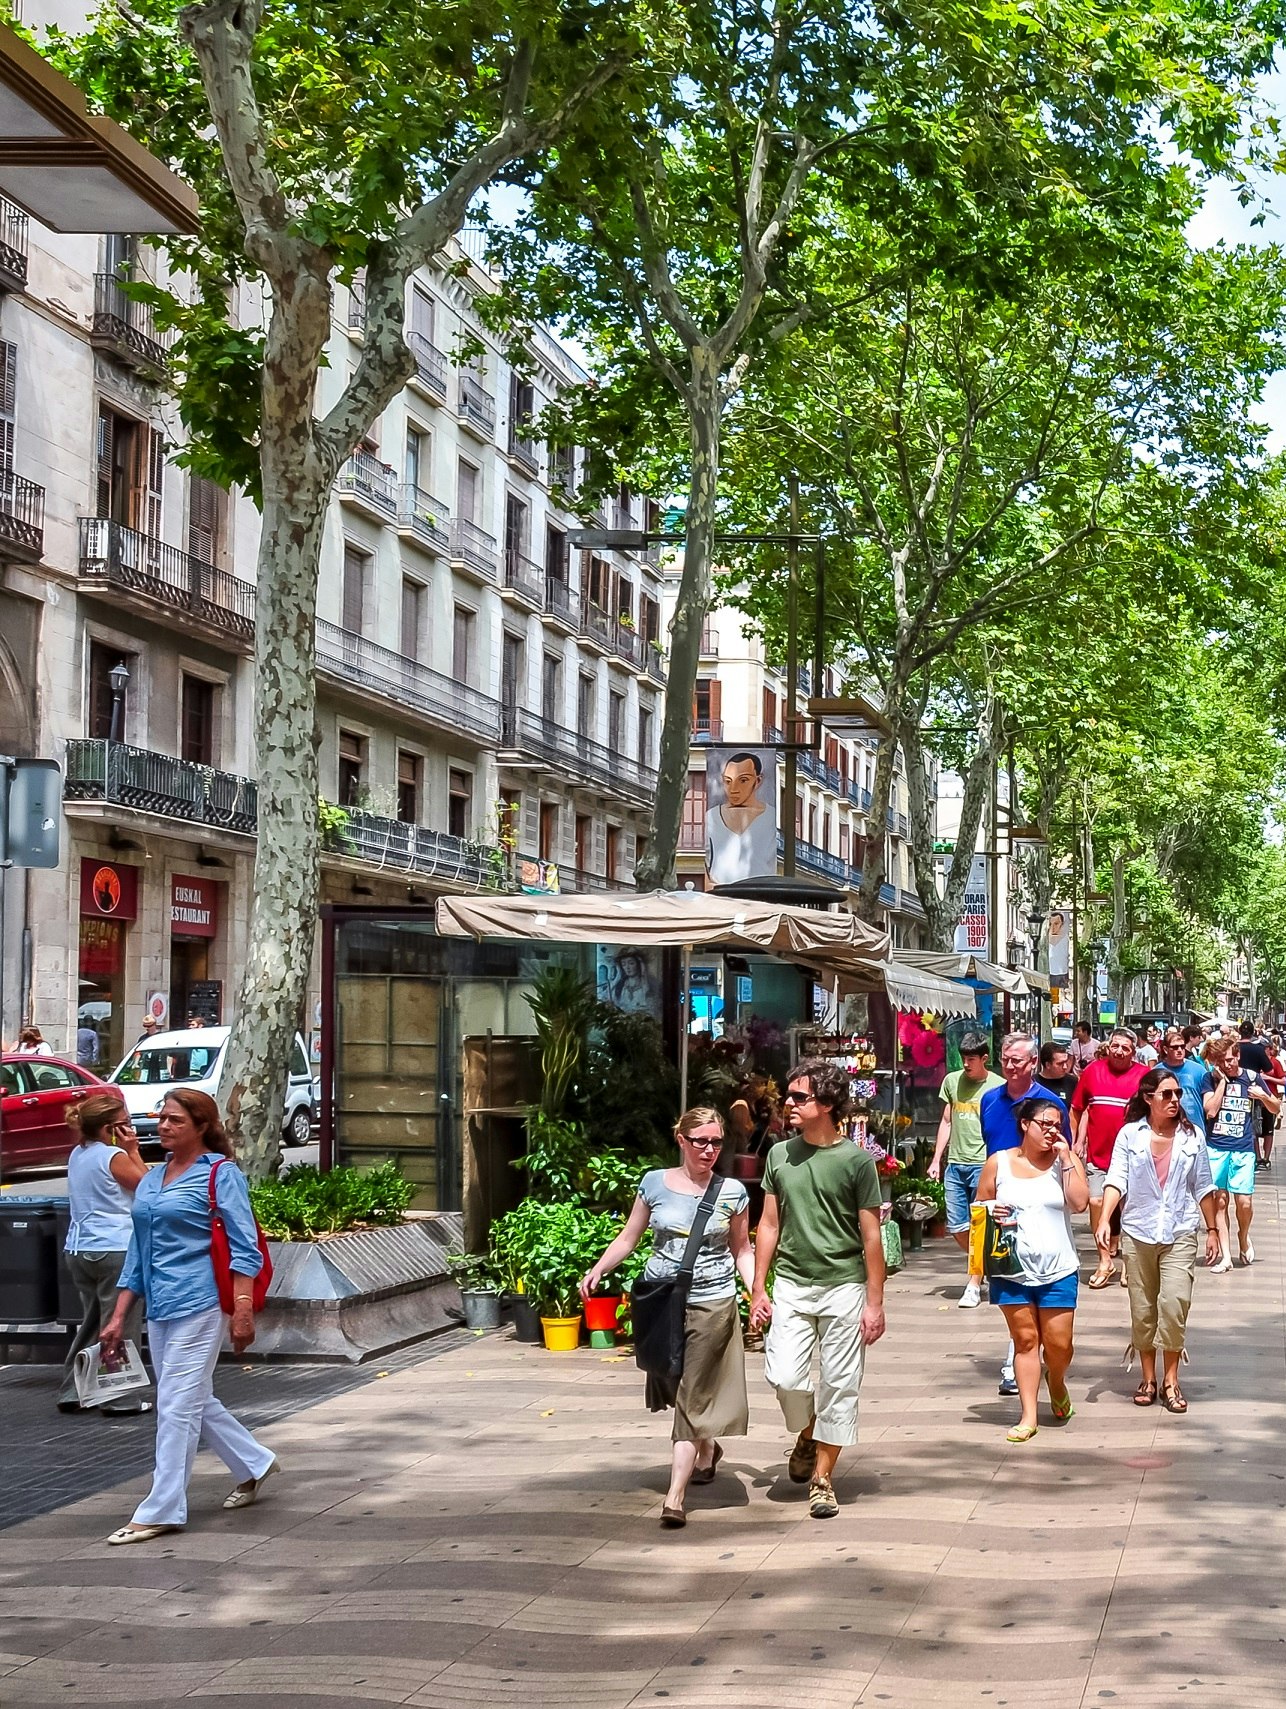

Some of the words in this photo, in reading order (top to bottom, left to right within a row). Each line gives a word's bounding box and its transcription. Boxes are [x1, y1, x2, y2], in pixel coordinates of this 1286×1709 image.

[175, 886, 202, 904] EUSKAL
[964, 893, 985, 904] ORAR
[171, 906, 210, 924] ESTAURANT
[960, 915, 986, 925] CASSO
[967, 926, 986, 936] 1900
[967, 937, 986, 947] 1907
[1220, 1111, 1244, 1123] LOVE
